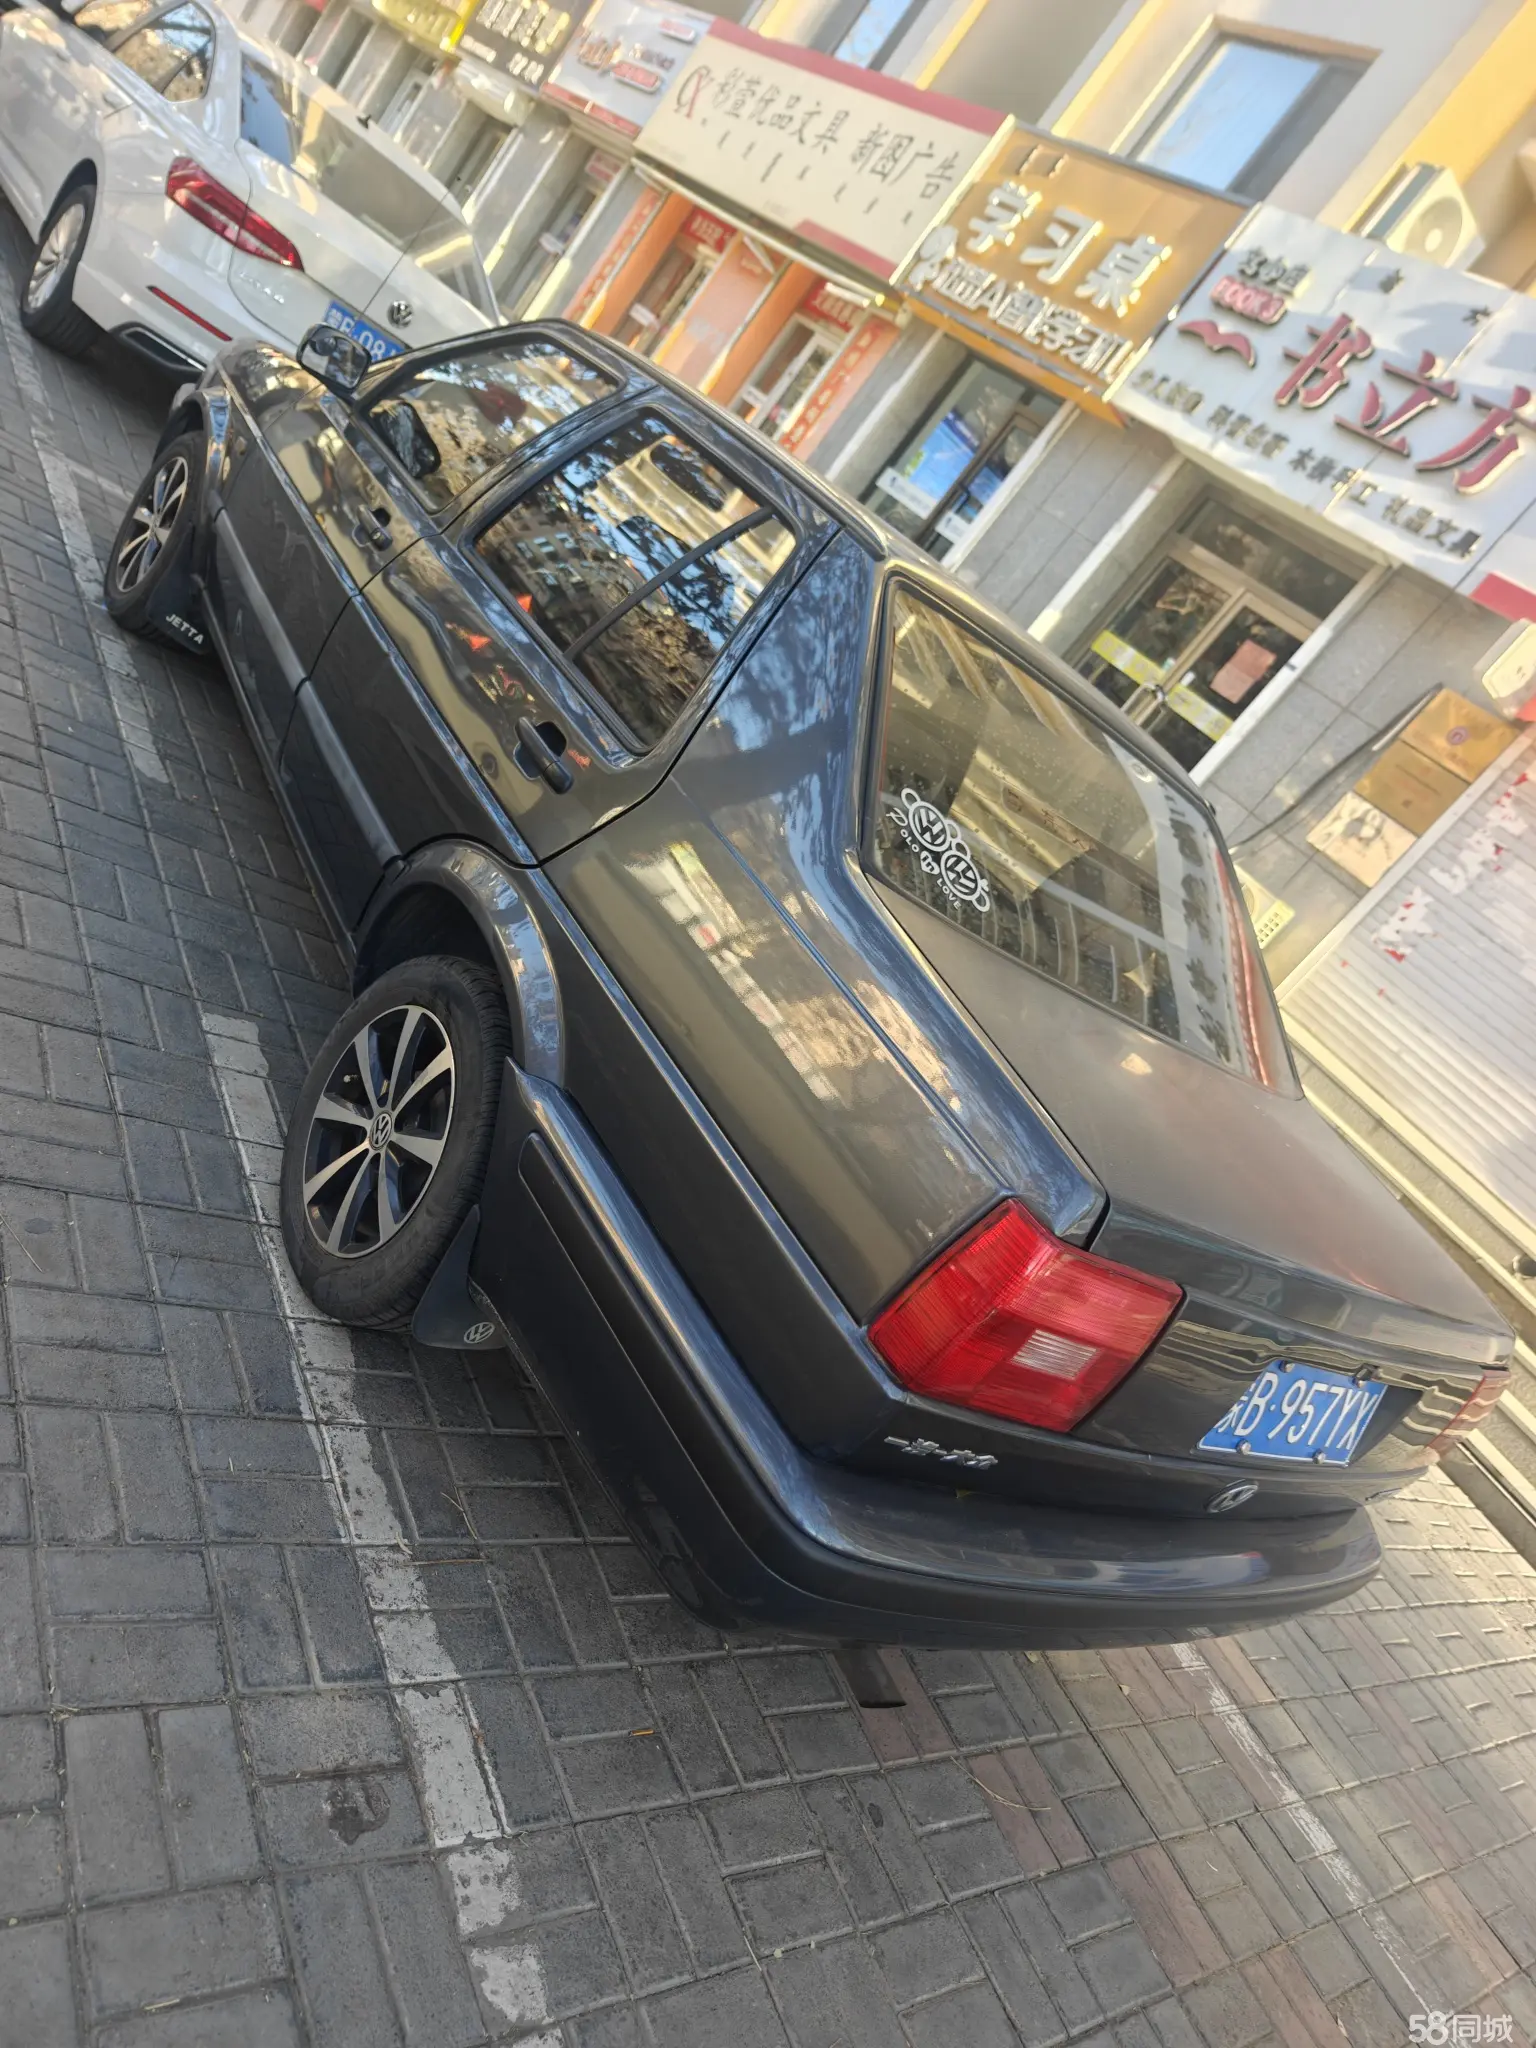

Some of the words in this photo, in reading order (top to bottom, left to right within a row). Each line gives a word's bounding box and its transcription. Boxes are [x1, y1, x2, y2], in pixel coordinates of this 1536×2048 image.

[850, 121, 959, 200] 新图广告
[966, 179, 1173, 319] 学习桌
[165, 613, 204, 645] JETTA
[936, 877, 961, 910] LOVE
